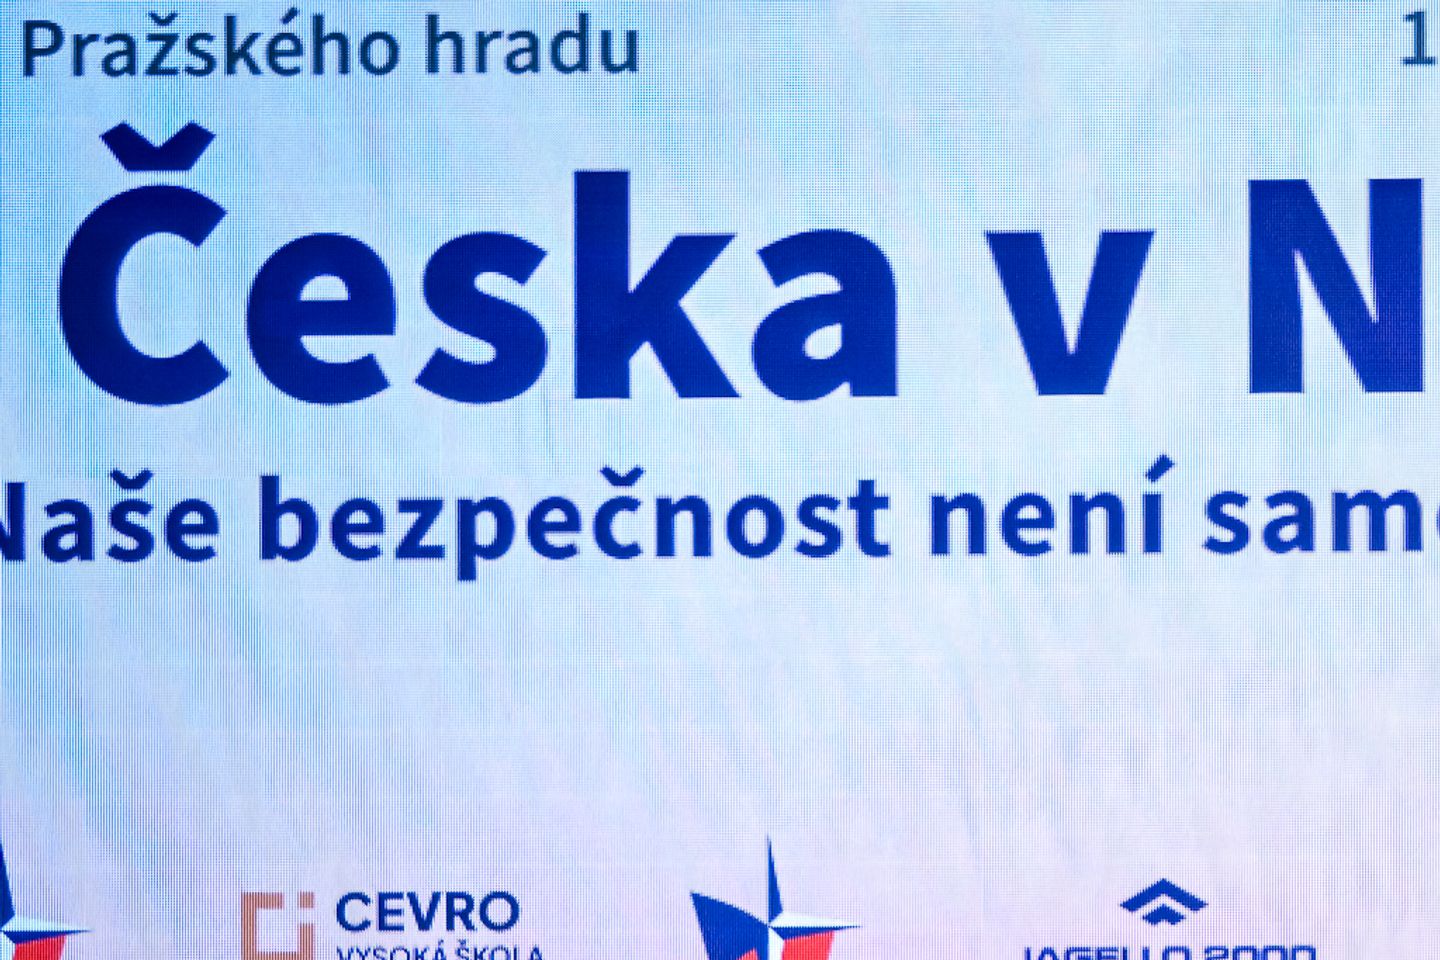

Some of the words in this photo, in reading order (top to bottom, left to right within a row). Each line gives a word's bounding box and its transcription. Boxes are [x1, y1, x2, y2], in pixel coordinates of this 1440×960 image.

[22, 8, 400, 77] Pražského
[426, 12, 638, 75] hradu
[58, 122, 897, 406] Česka
[986, 231, 1153, 395] v
[260, 466, 890, 582] bezpečnost
[931, 455, 1175, 556] není
[336, 891, 520, 933] CEVRO
